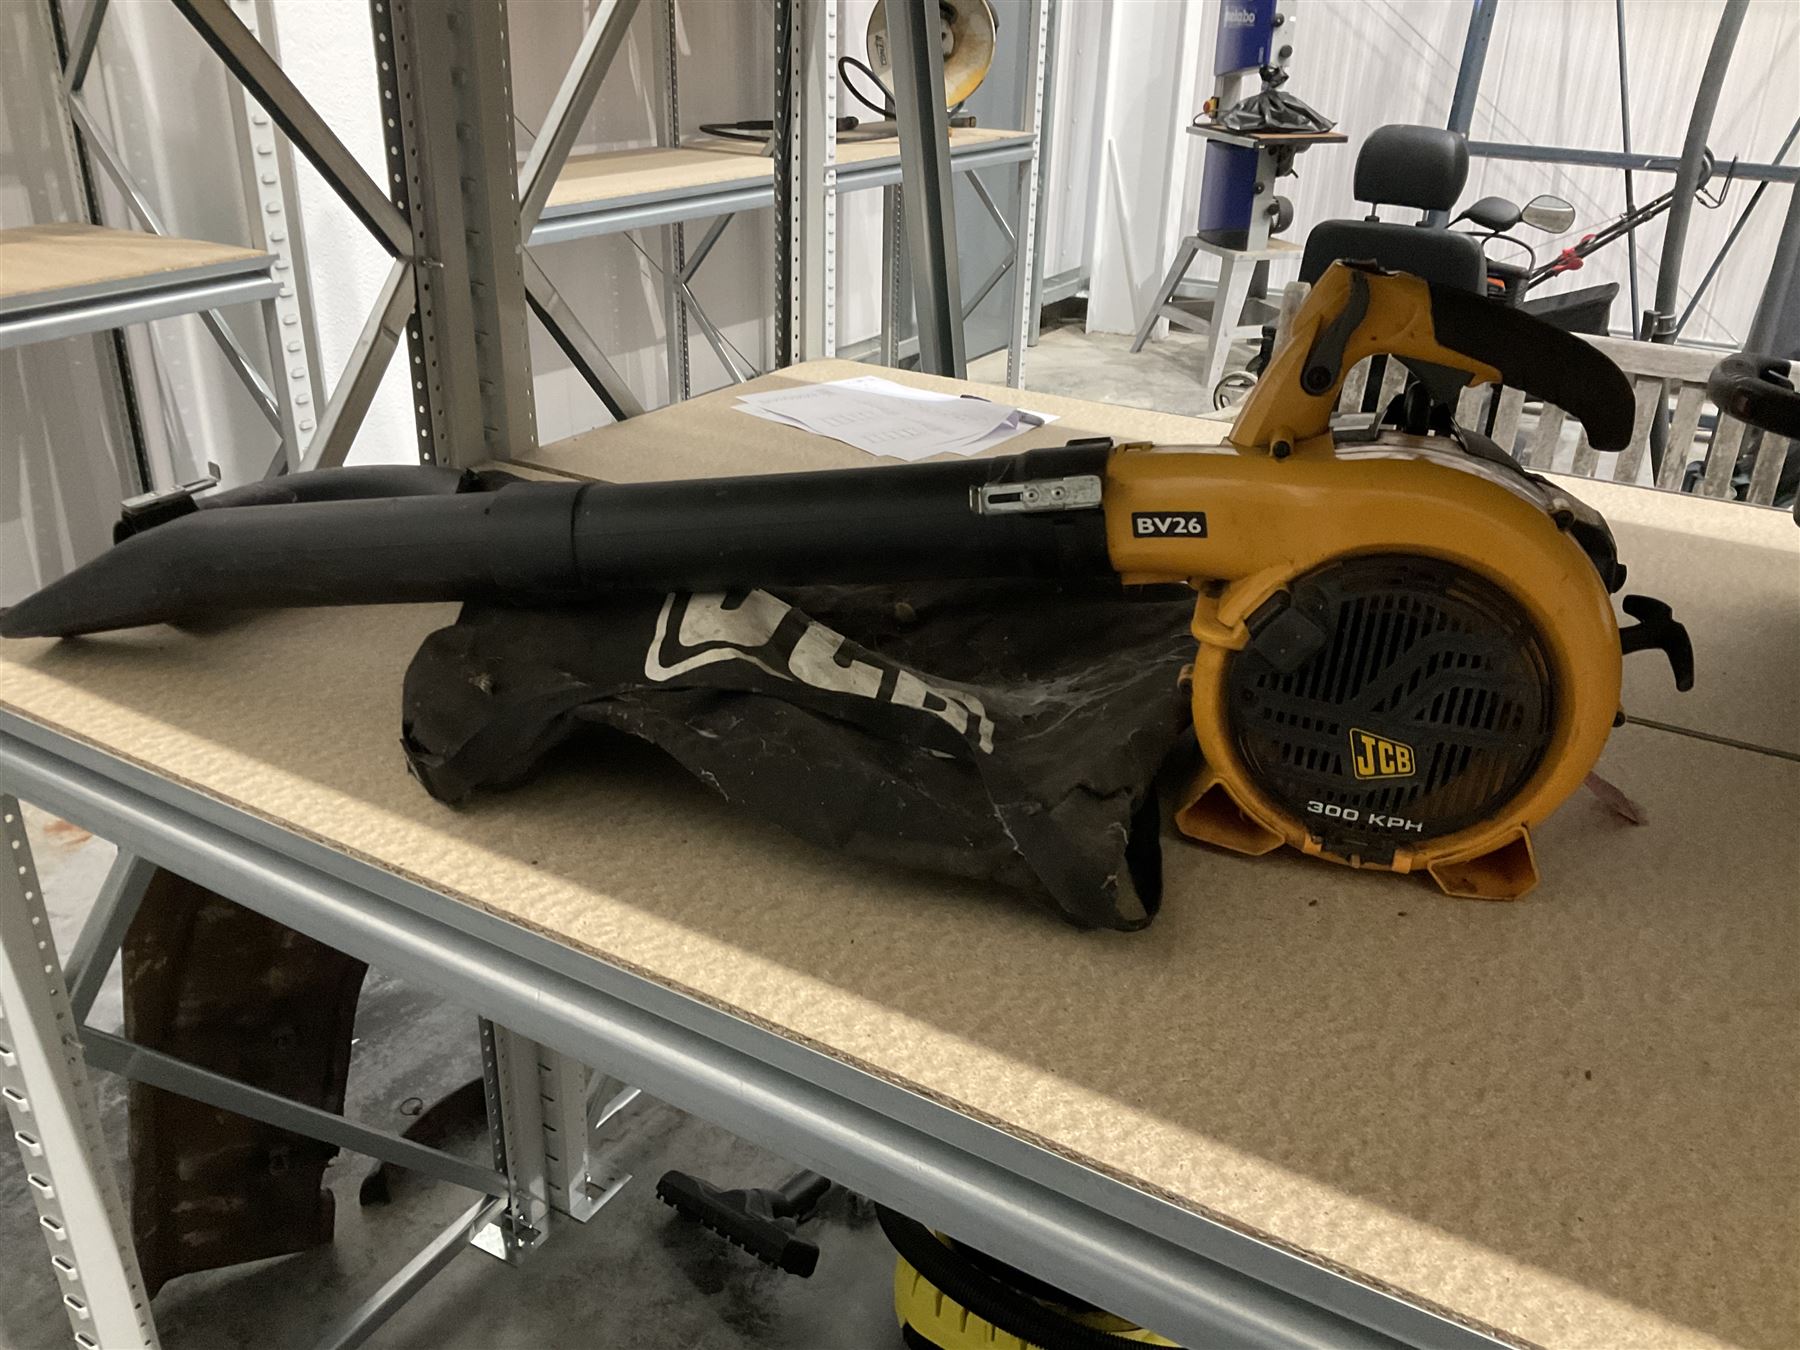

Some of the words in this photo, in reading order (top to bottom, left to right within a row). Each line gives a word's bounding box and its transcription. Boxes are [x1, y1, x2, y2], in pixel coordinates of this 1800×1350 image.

[1136, 517, 1202, 534] BV26
[1357, 735, 1411, 776] JCB
[1307, 801, 1360, 821] 300
[1368, 813, 1423, 832] KPH
